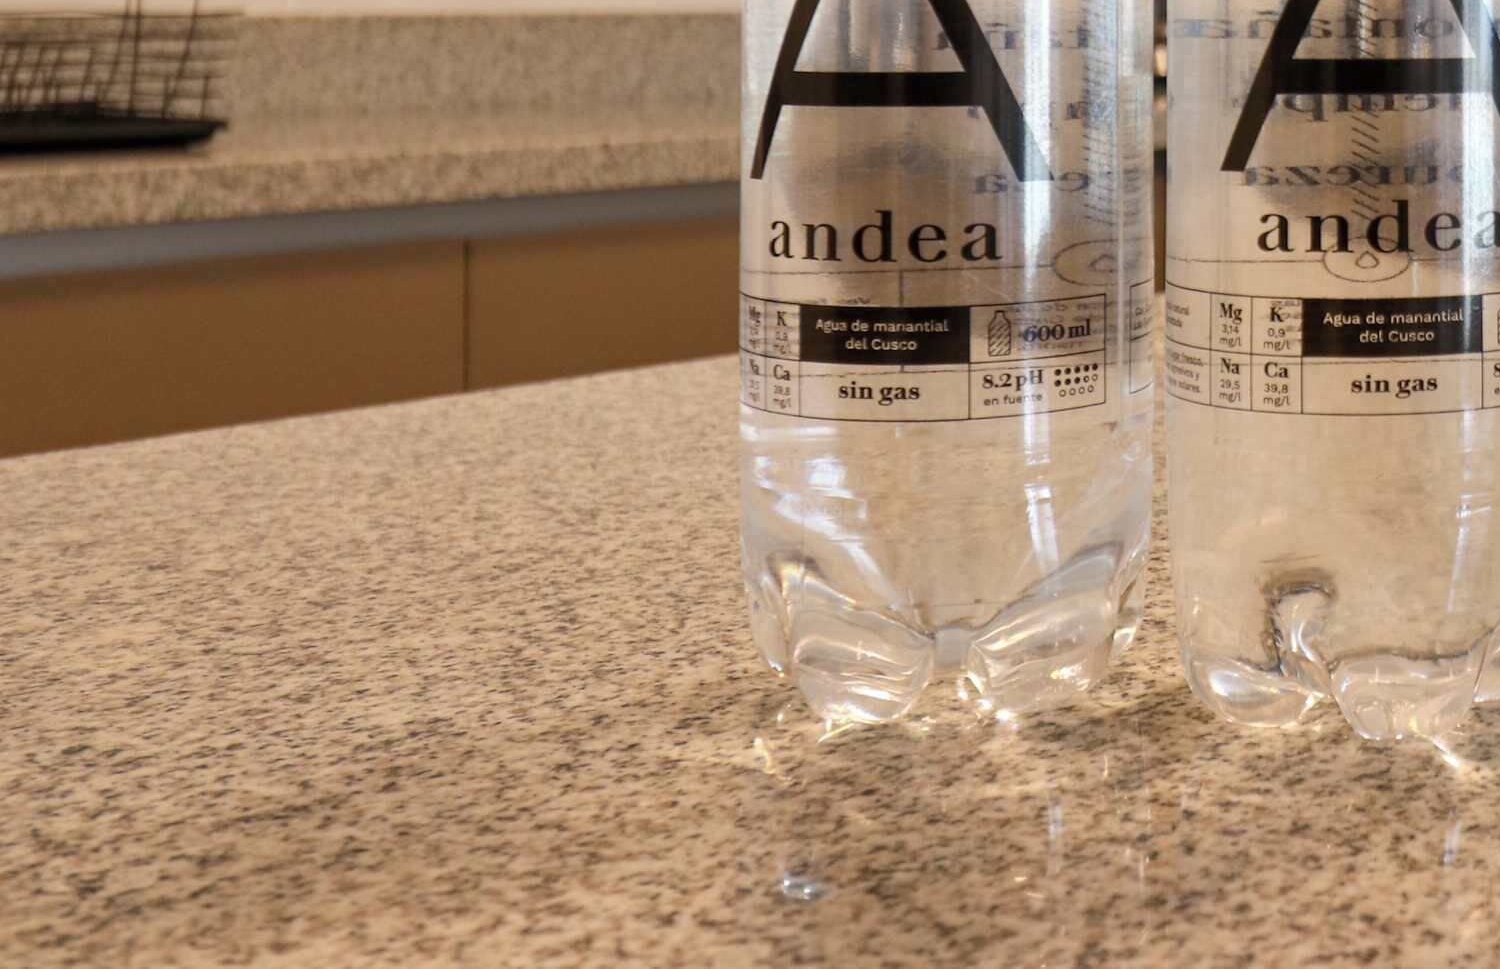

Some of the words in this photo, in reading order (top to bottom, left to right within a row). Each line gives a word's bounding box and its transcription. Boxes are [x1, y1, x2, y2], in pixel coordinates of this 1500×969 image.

[768, 209, 1003, 264] andea
[776, 310, 787, 327] K
[1219, 303, 1242, 324] Mg
[1270, 307, 1283, 322] K
[1323, 312, 1361, 326] Agua
[1366, 311, 1385, 324] de
[1391, 309, 1463, 323] manantial
[816, 319, 847, 333] Agua
[851, 319, 869, 332] de
[873, 319, 949, 333] manantial
[1023, 323, 1065, 342] 600
[1068, 318, 1091, 337] ml
[1222, 324, 1239, 335] 3,14
[1267, 328, 1285, 338] 0,9
[1219, 336, 1241, 347] mg/l
[1359, 330, 1383, 343] del
[1388, 329, 1434, 342] Cusco
[845, 338, 867, 350] del
[871, 338, 917, 351] Cusco
[1264, 340, 1290, 351] mg/l
[773, 364, 791, 382] Ca
[1219, 358, 1241, 375] Na
[1263, 362, 1289, 379] Ca
[982, 374, 1012, 389] 8.2
[1015, 369, 1043, 390] pH
[1220, 379, 1241, 390] 29,5
[1350, 375, 1390, 394] sin
[1395, 378, 1438, 398] gas
[838, 381, 873, 400] sin
[878, 386, 920, 406] gas
[1263, 383, 1289, 394] 39,8
[983, 398, 999, 407] en
[1218, 391, 1241, 403] mg/l
[1263, 395, 1290, 407] mg/l
